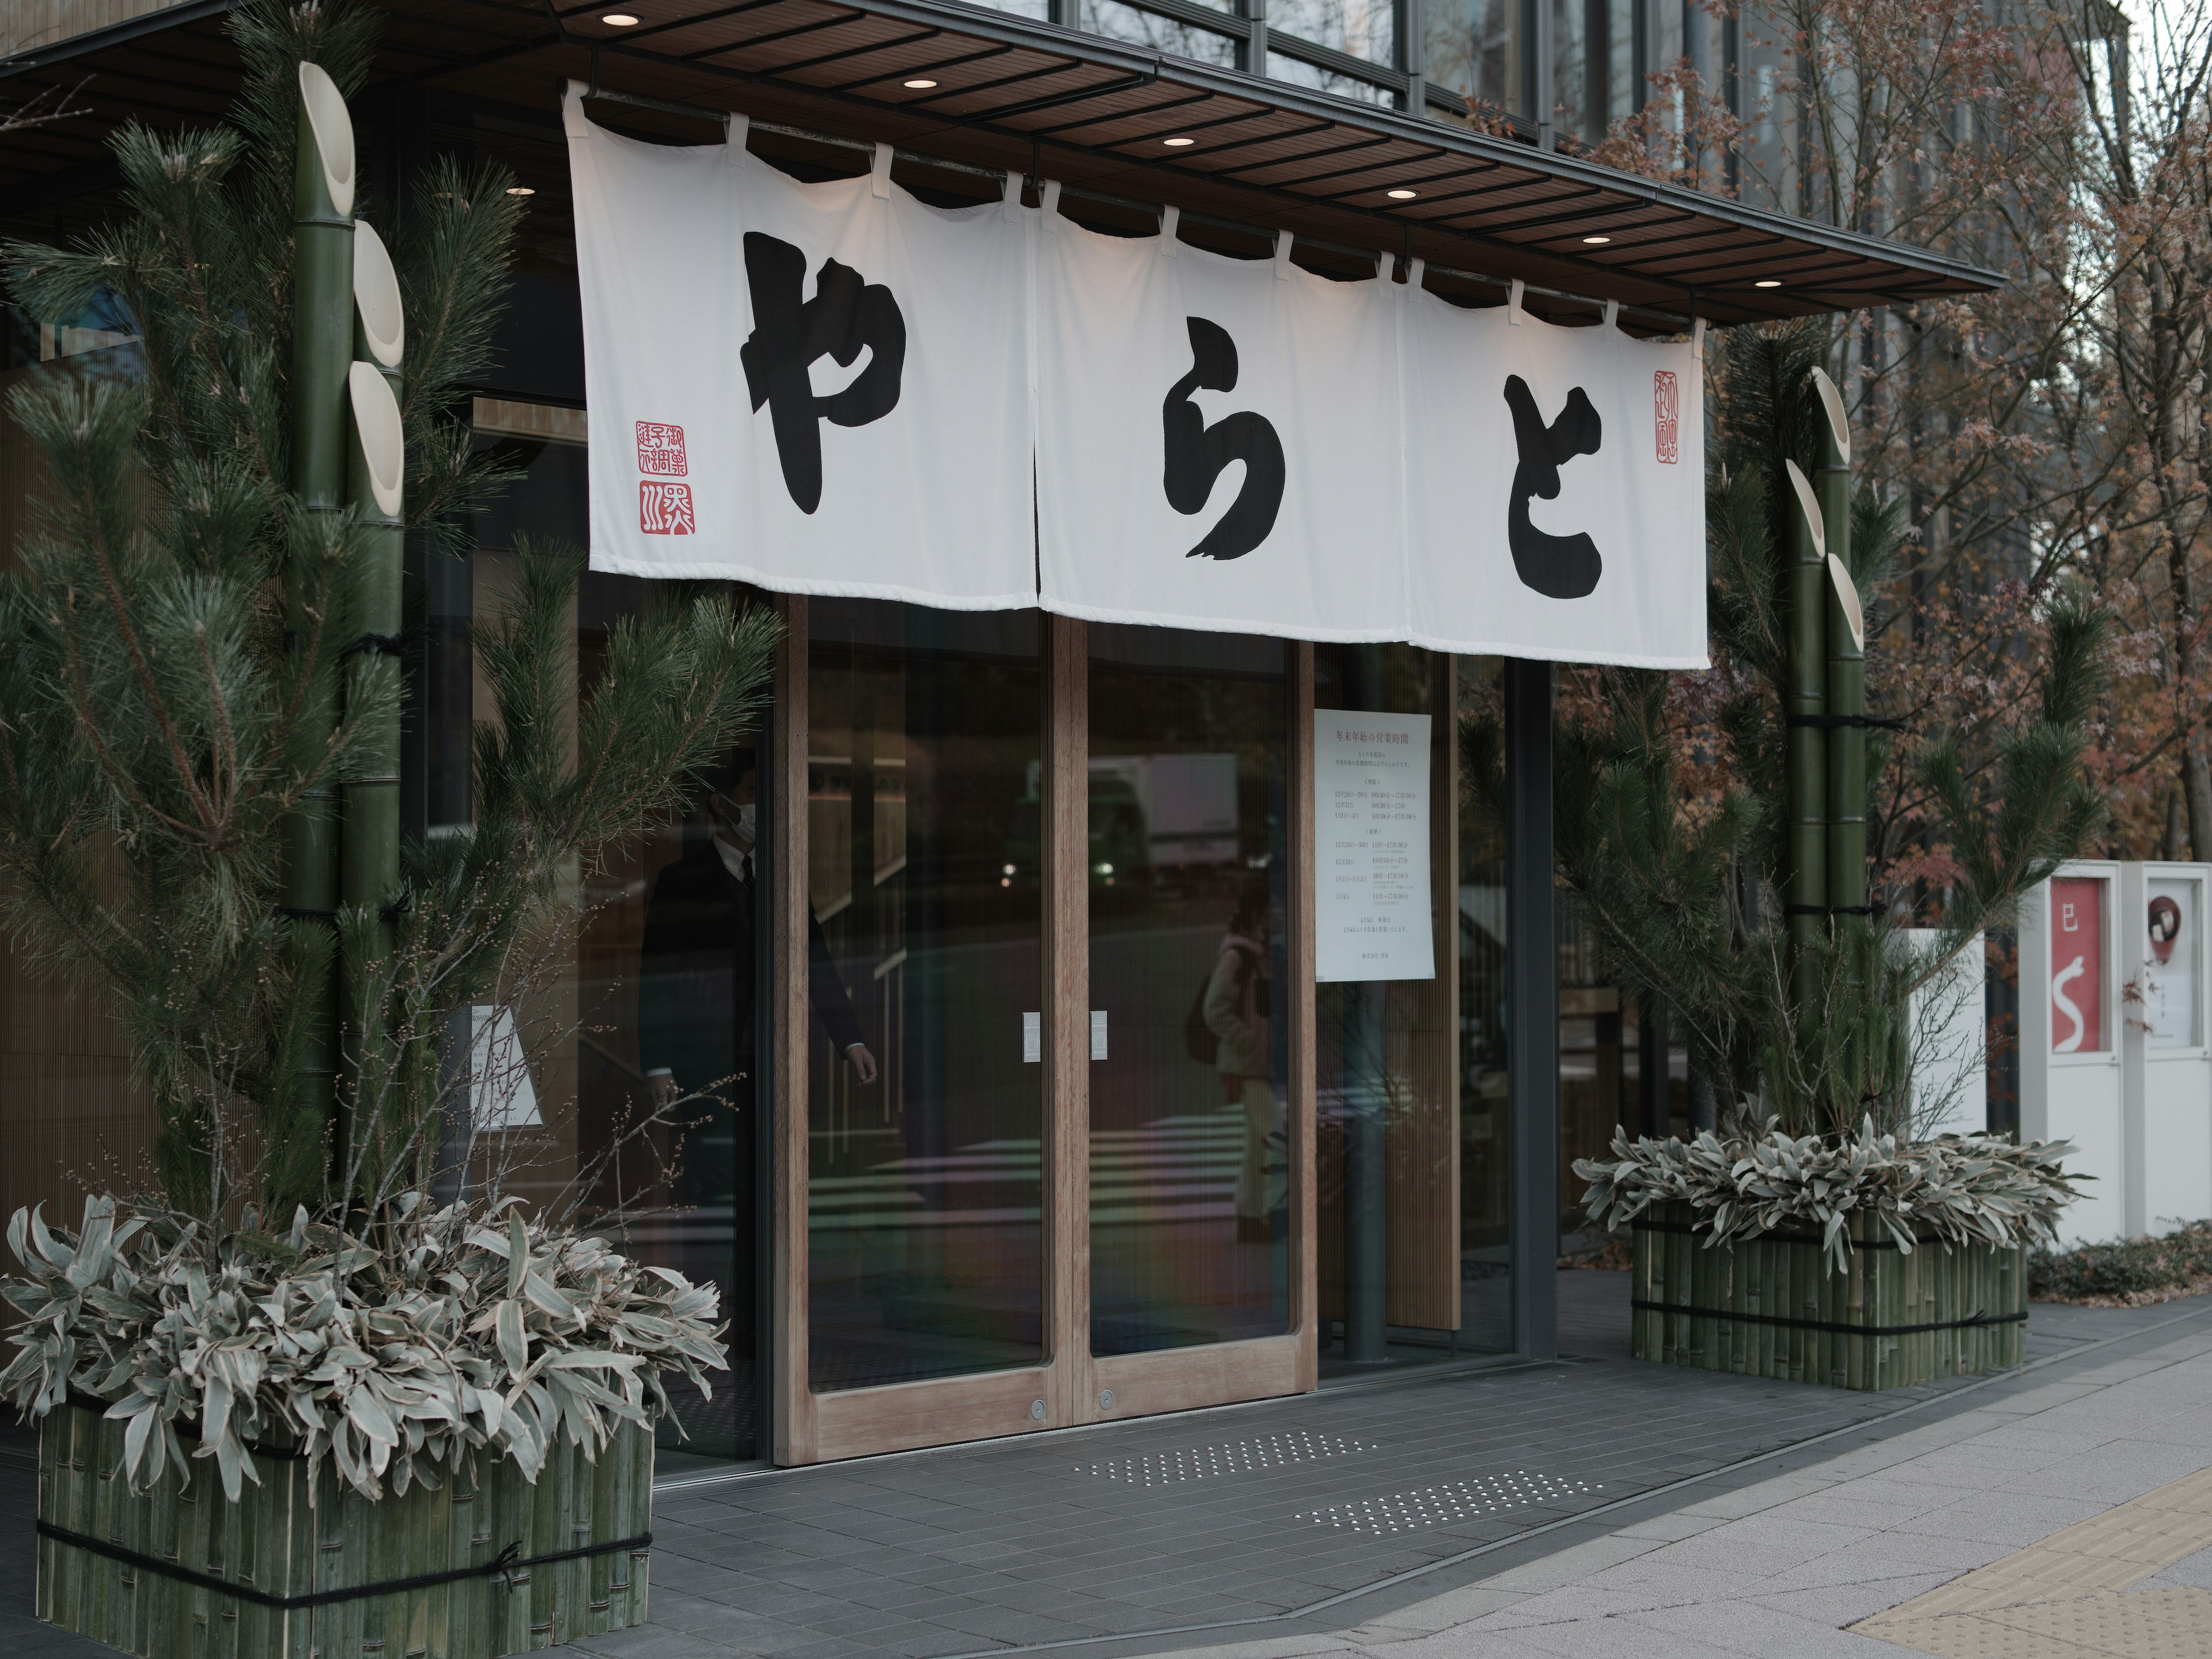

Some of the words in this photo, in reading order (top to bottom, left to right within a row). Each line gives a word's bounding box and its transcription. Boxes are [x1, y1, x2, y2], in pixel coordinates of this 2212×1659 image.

[1336, 730, 1408, 744] 年末年始の営業時間
